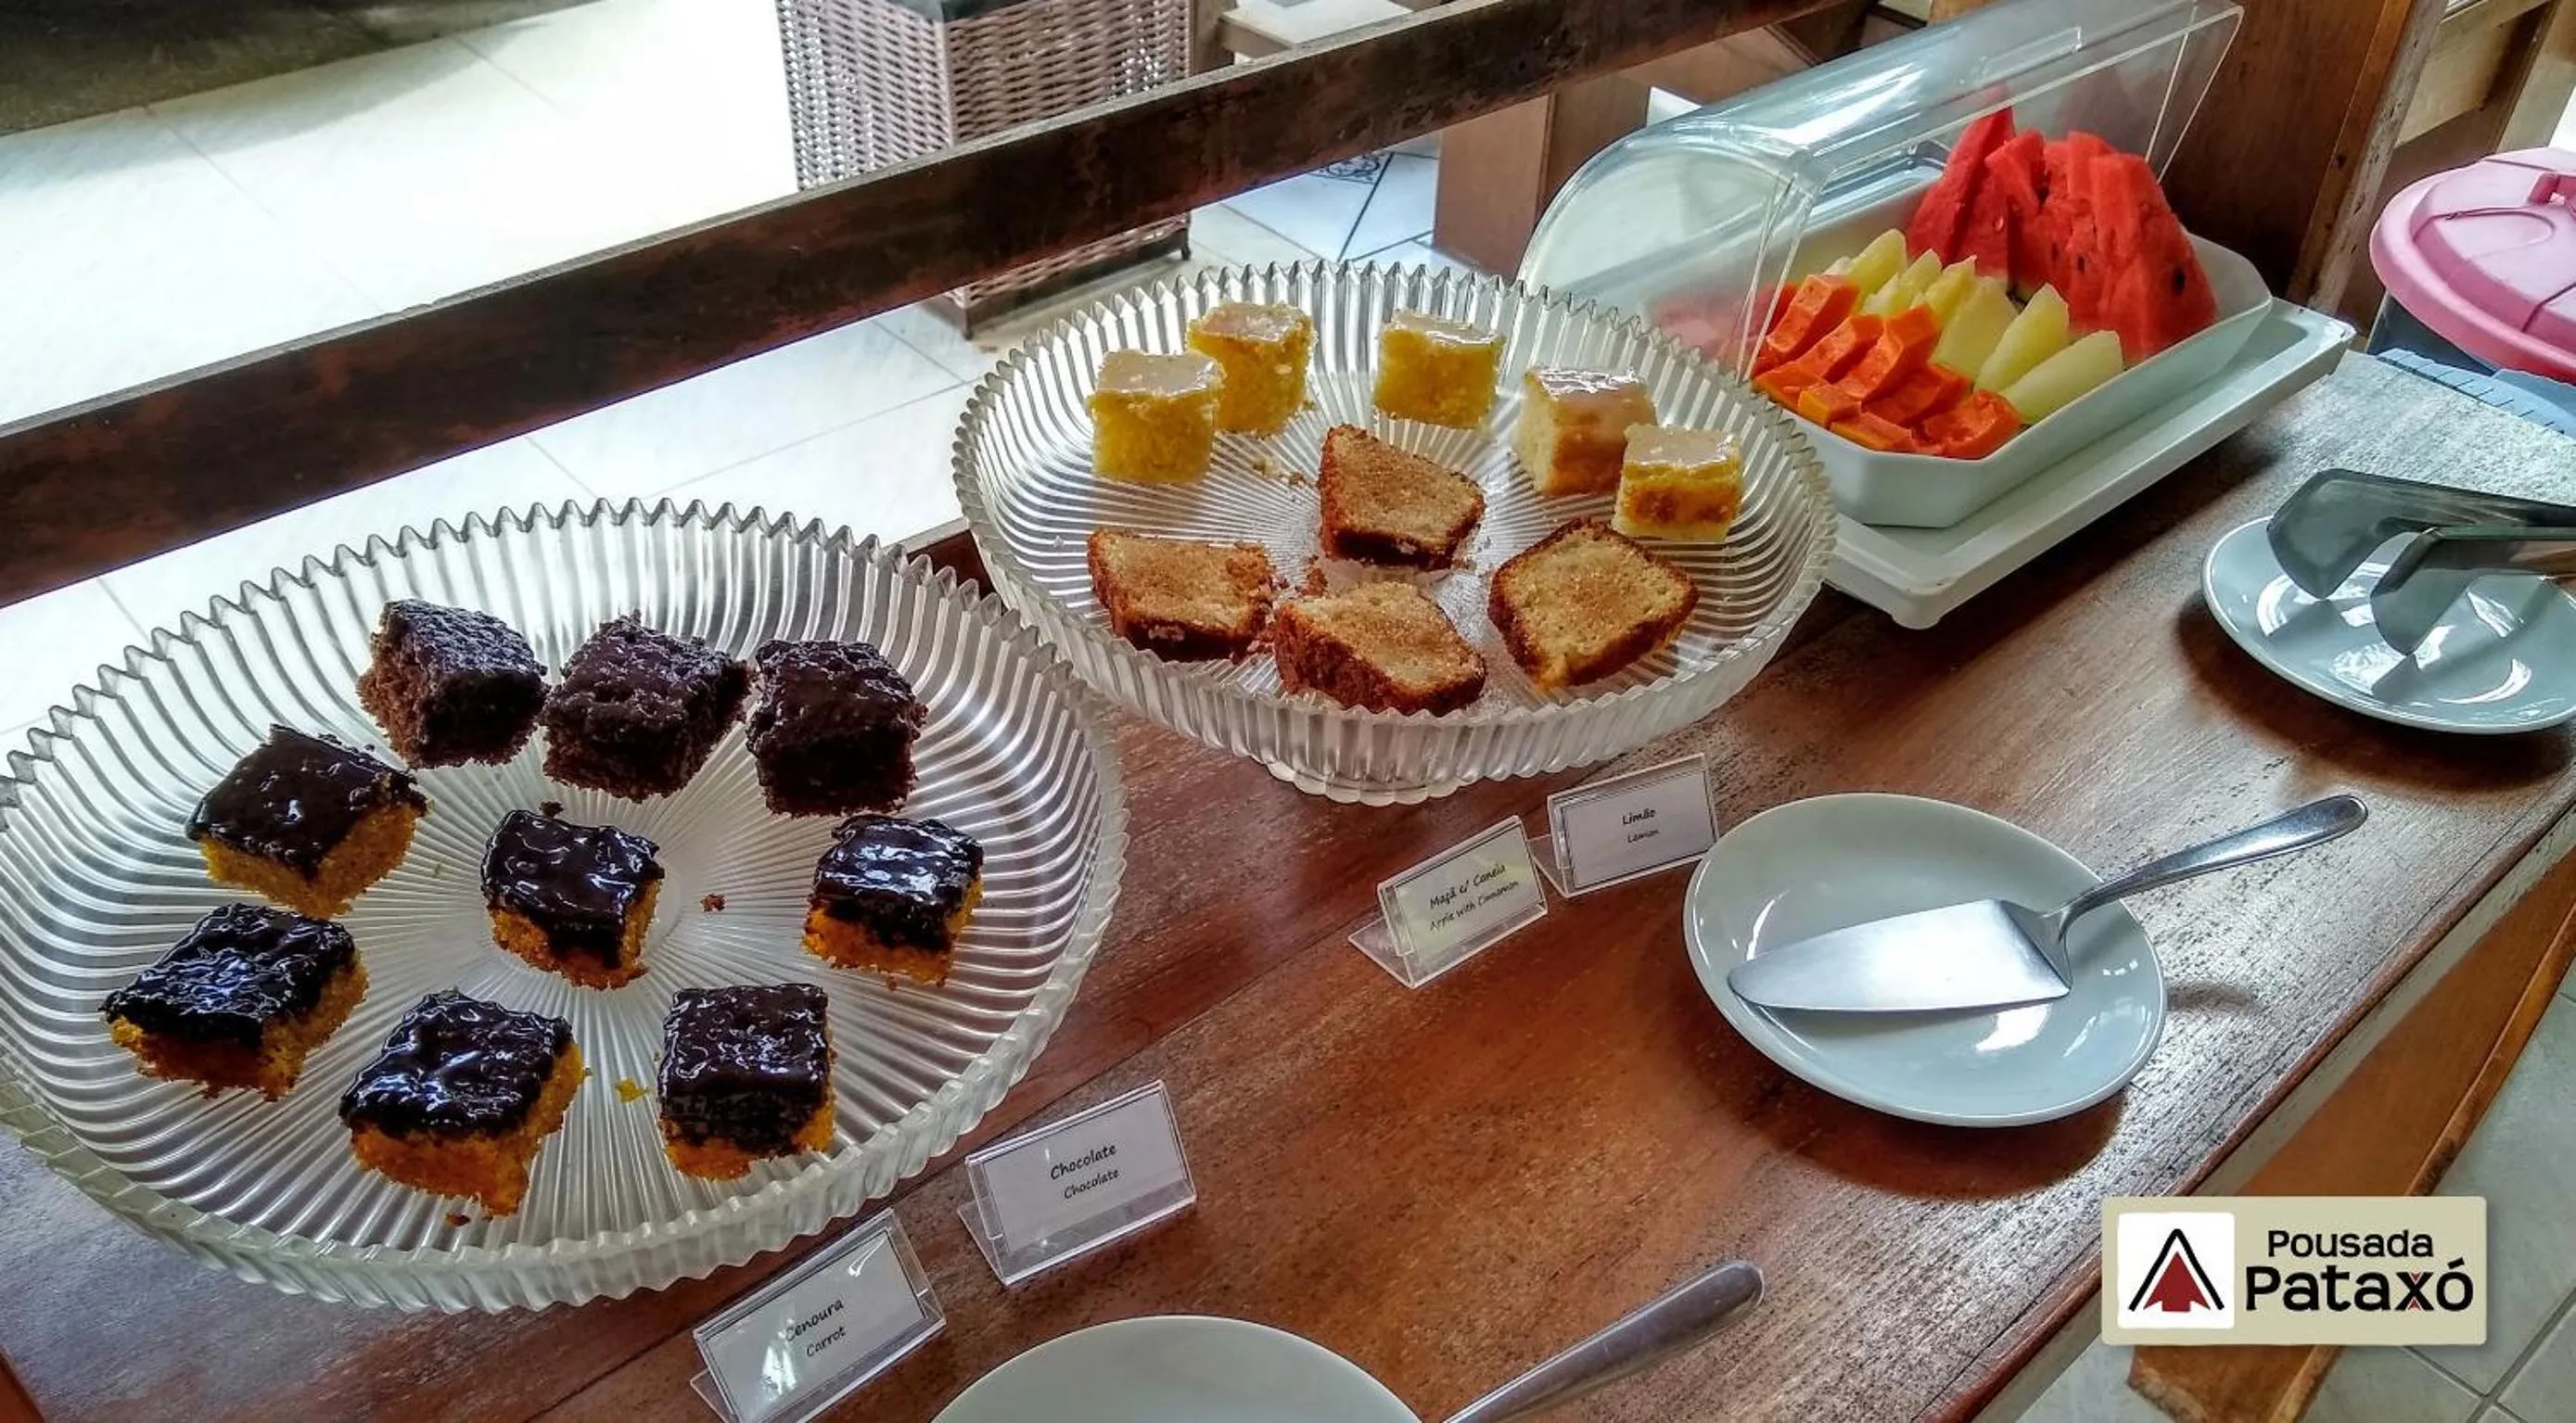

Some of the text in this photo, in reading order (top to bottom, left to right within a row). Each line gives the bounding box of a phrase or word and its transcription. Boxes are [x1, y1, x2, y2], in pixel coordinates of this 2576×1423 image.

[1622, 807, 1656, 825] Limão
[1430, 886, 1457, 909] Maçã
[1429, 911, 1455, 933] Apple
[1456, 901, 1476, 919] with
[1050, 1142, 1117, 1181] Chocolate
[1064, 1167, 1120, 1200] Chocolate
[785, 1298, 845, 1342] Cenoura
[806, 1326, 847, 1357] Carrot
